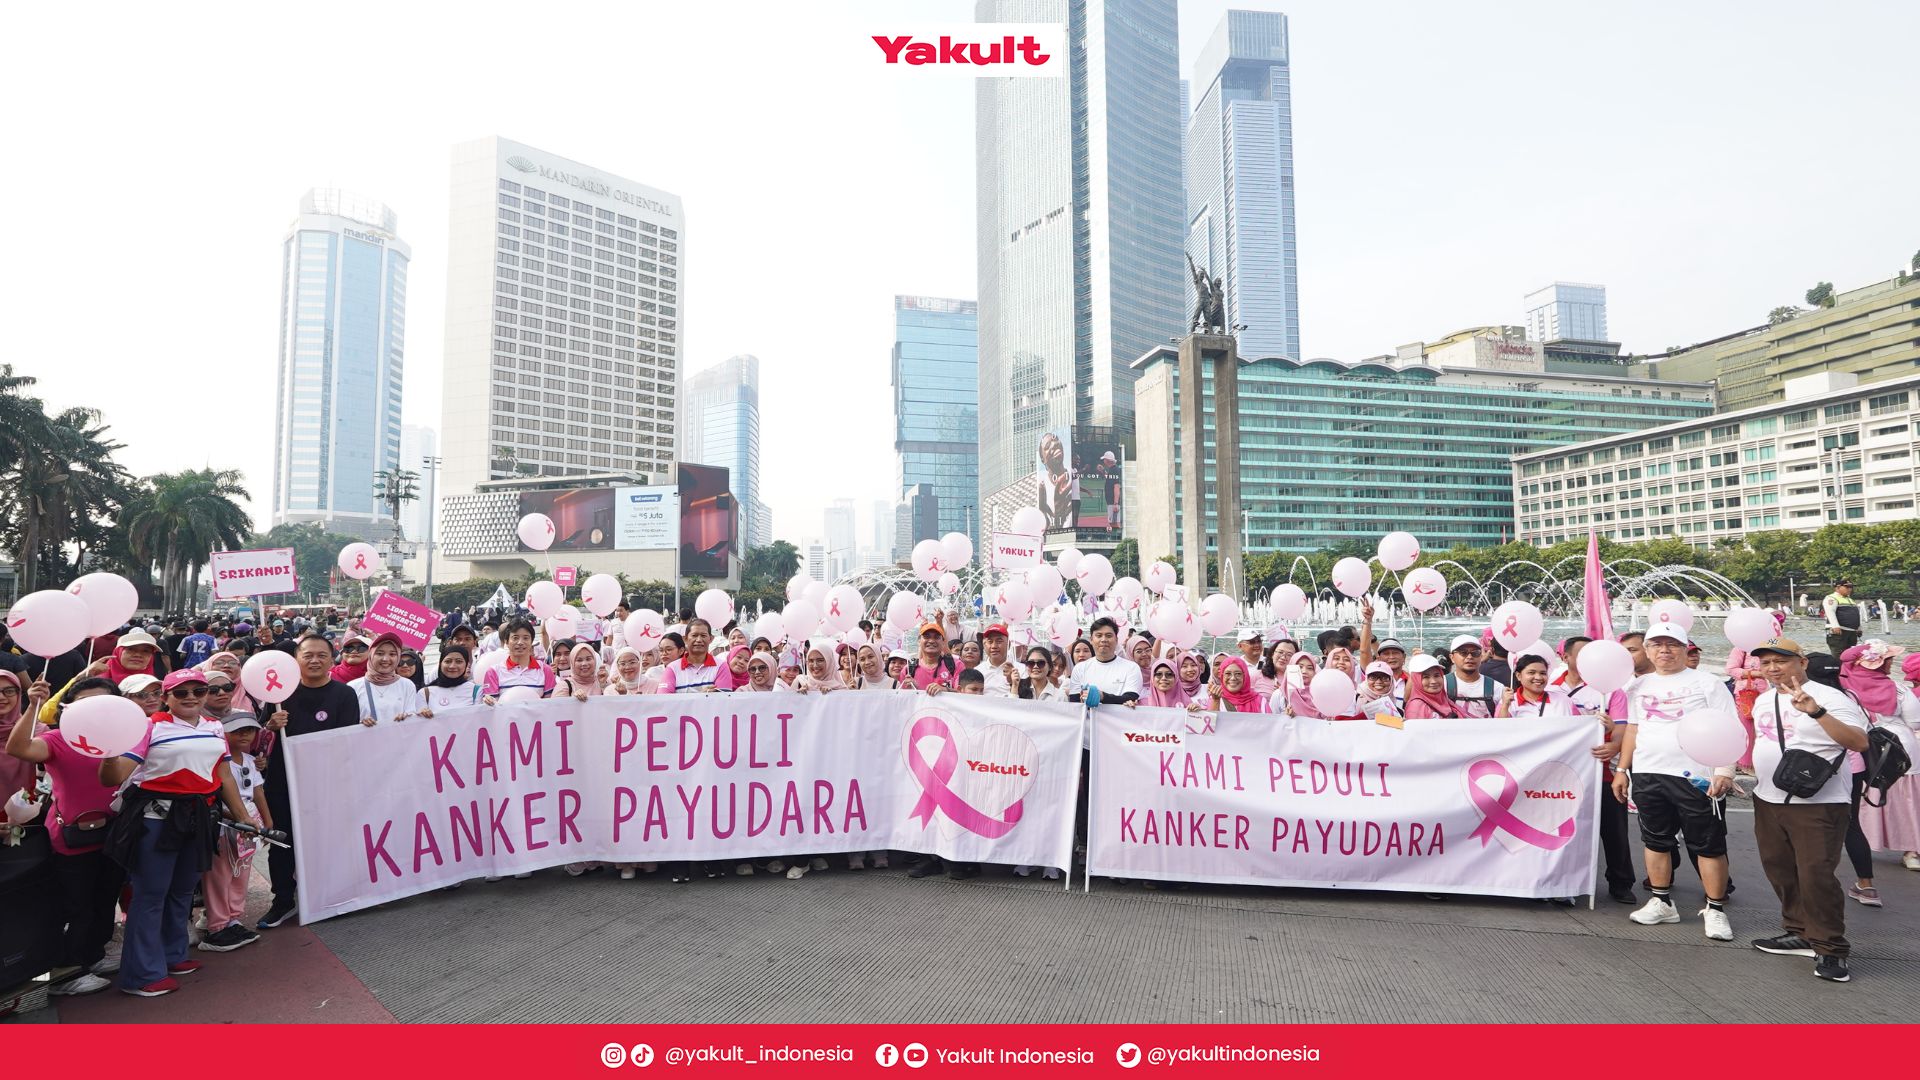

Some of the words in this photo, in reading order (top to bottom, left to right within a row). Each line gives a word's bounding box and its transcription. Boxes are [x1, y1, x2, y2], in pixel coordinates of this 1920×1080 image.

[539, 165, 611, 197] MANDARIN
[613, 189, 672, 217] ORIENTAL
[999, 546, 1035, 558] YAKULT
[218, 565, 291, 580] SRIKANDI
[386, 604, 409, 617] LIONS
[408, 613, 426, 625] CLUB
[387, 613, 418, 629] JAKARTA
[192, 640, 207, 654] 12
[1124, 733, 1181, 744] Yakult
[429, 720, 575, 794] KAMI
[614, 714, 793, 772] PEDULI
[966, 759, 1030, 777] Yakult
[1159, 750, 1245, 791] KAMI
[1269, 758, 1392, 797] PEDULI
[1523, 789, 1576, 801] Yakult
[363, 789, 583, 883] KANKER
[613, 779, 868, 843] PAYUDARA
[1120, 807, 1250, 851] KANKER
[1271, 816, 1444, 857] PAYUDARA
